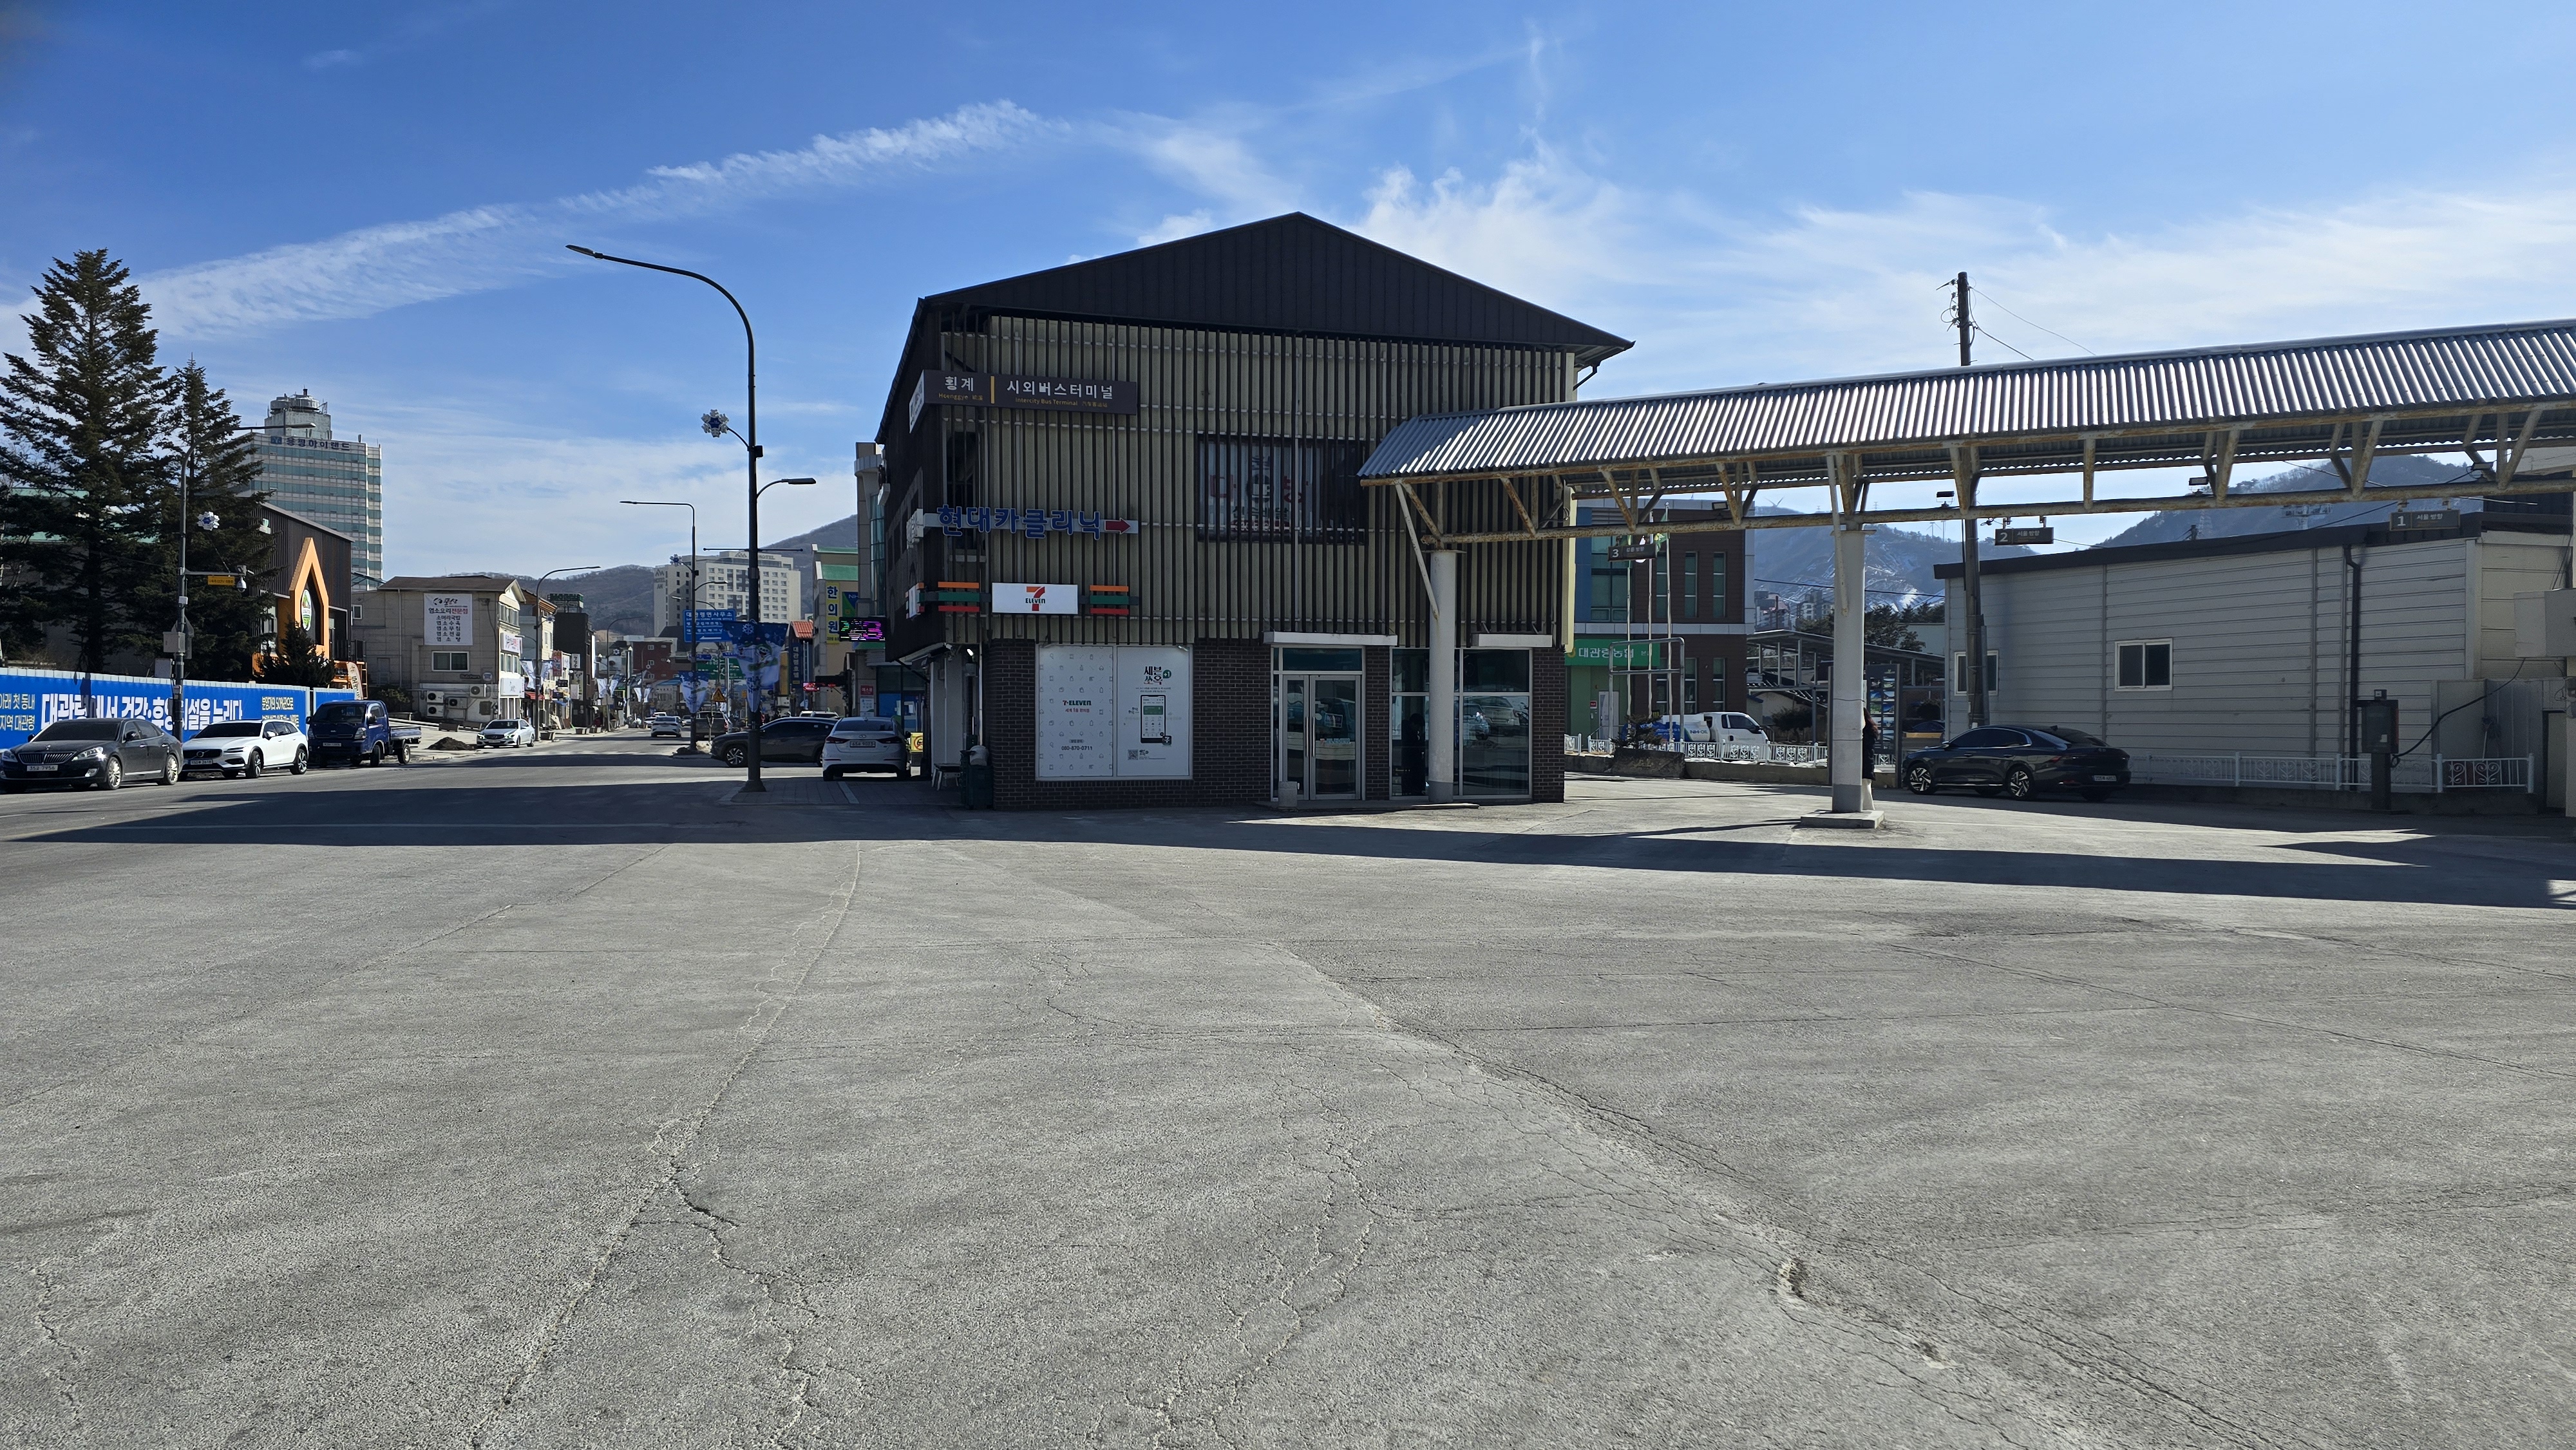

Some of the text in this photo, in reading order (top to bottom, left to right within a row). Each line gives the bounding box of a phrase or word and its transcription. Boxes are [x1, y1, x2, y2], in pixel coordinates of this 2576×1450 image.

[945, 376, 974, 391] 횡계
[1007, 380, 1113, 399] 시외버스터미널
[286, 437, 350, 451] 용평하이랜드
[937, 504, 1101, 540] 현대카클리닉
[2397, 516, 2406, 526] 1
[2000, 532, 2008, 542] 2
[1612, 549, 1619, 558] 3
[827, 585, 838, 634] 한의원
[1578, 647, 1634, 658] 대관령농협
[1144, 666, 1162, 675] 세븐
[13, 693, 20, 710] 첫
[121, 695, 211, 731] 건강·휴설을
[213, 699, 243, 720] 누리다
[0, 715, 35, 731] 지역 대관령
